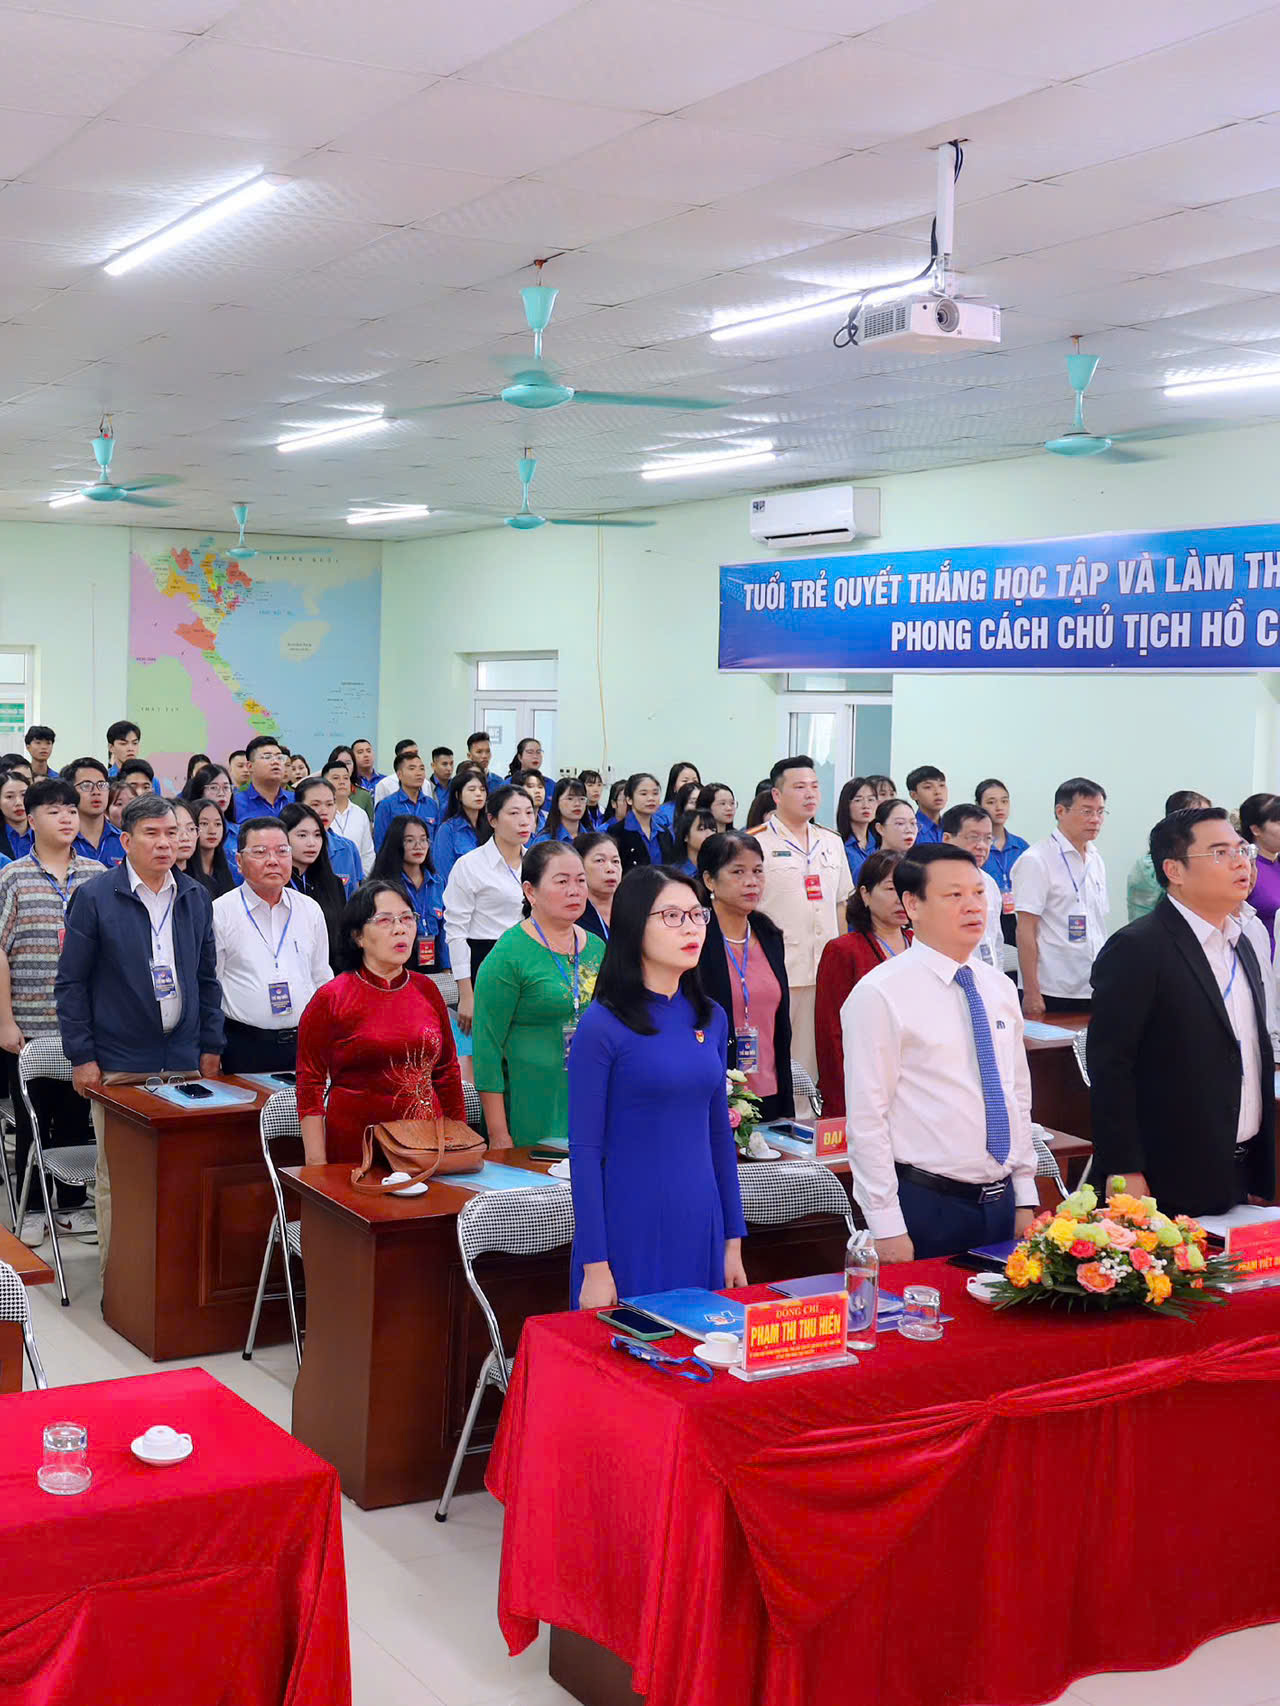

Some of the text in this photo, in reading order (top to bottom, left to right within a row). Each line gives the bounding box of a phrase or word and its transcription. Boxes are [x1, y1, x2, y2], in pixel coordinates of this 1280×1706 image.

[744, 570, 785, 611] TUỔI
[792, 569, 828, 609] TRẺ
[833, 565, 902, 610] QUYẾT
[908, 559, 987, 604] THẮNG
[994, 565, 1048, 606] HỌC
[1056, 555, 1109, 604] TẬP
[1118, 551, 1155, 594] VÀ
[1165, 547, 1234, 593] LÀM
[891, 618, 972, 651] PHONG
[980, 610, 1049, 650] CÁCH
[1057, 603, 1114, 649] CHỦ
[1122, 611, 1192, 656] TỊCH
[1201, 597, 1245, 647] HỒ
[751, 1323, 780, 1349] PHẠM
[782, 1320, 797, 1345] THỊ
[799, 1318, 817, 1339] THU
